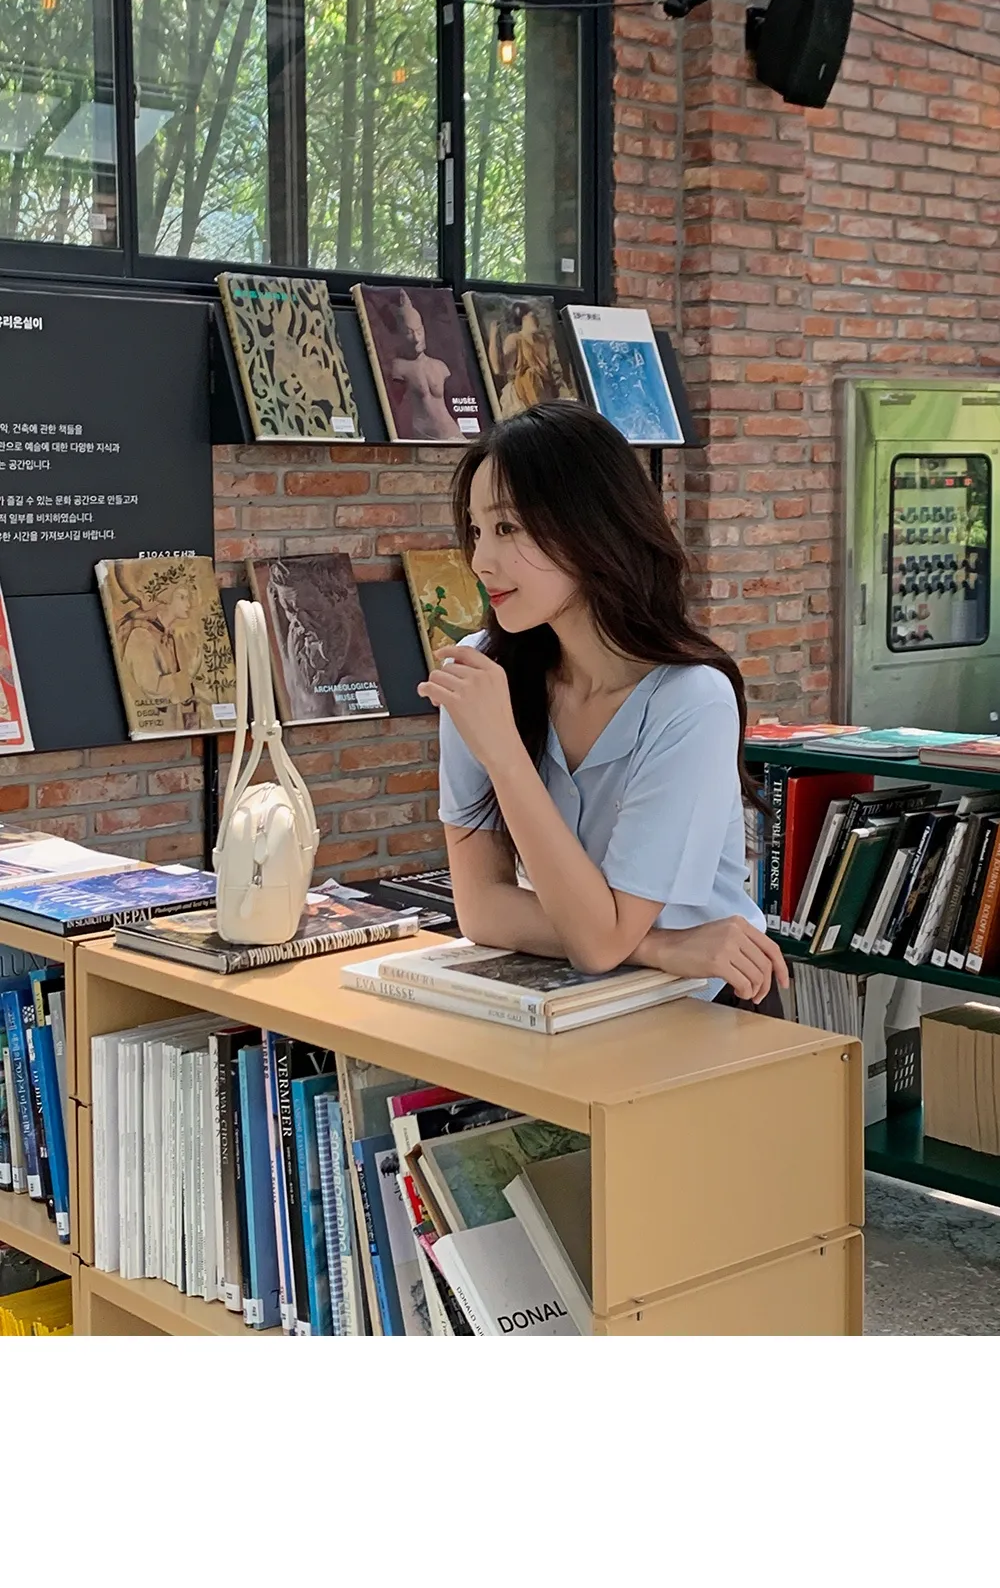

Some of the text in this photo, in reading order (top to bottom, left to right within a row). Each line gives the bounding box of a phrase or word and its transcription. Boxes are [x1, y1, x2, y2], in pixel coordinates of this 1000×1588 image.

[453, 405, 479, 413] GUIMET
[13, 423, 37, 435] 건축에
[25, 441, 50, 452] 예술에
[52, 442, 68, 452] 대한
[70, 442, 94, 453] 다양한
[7, 495, 23, 507] 즐길
[26, 496, 34, 506] 수
[37, 495, 53, 506] 있는
[55, 496, 71, 506] 문화
[74, 495, 105, 506] 공간으로
[9, 513, 34, 524] 일부를
[13, 530, 38, 542] 시간을
[40, 530, 80, 541] 가져보시길
[314, 681, 378, 693] ARCHAEOLOGICAL
[134, 697, 173, 707] GALLERIA
[139, 718, 165, 728] UFFIZI
[773, 780, 783, 805] THE
[770, 851, 780, 891] HORSE
[355, 976, 377, 992] EVA
[380, 982, 416, 1001] HESSE
[277, 1054, 293, 1138] VERMEER
[456, 1286, 478, 1322] DONALD
[497, 1300, 567, 1334] DONAL
